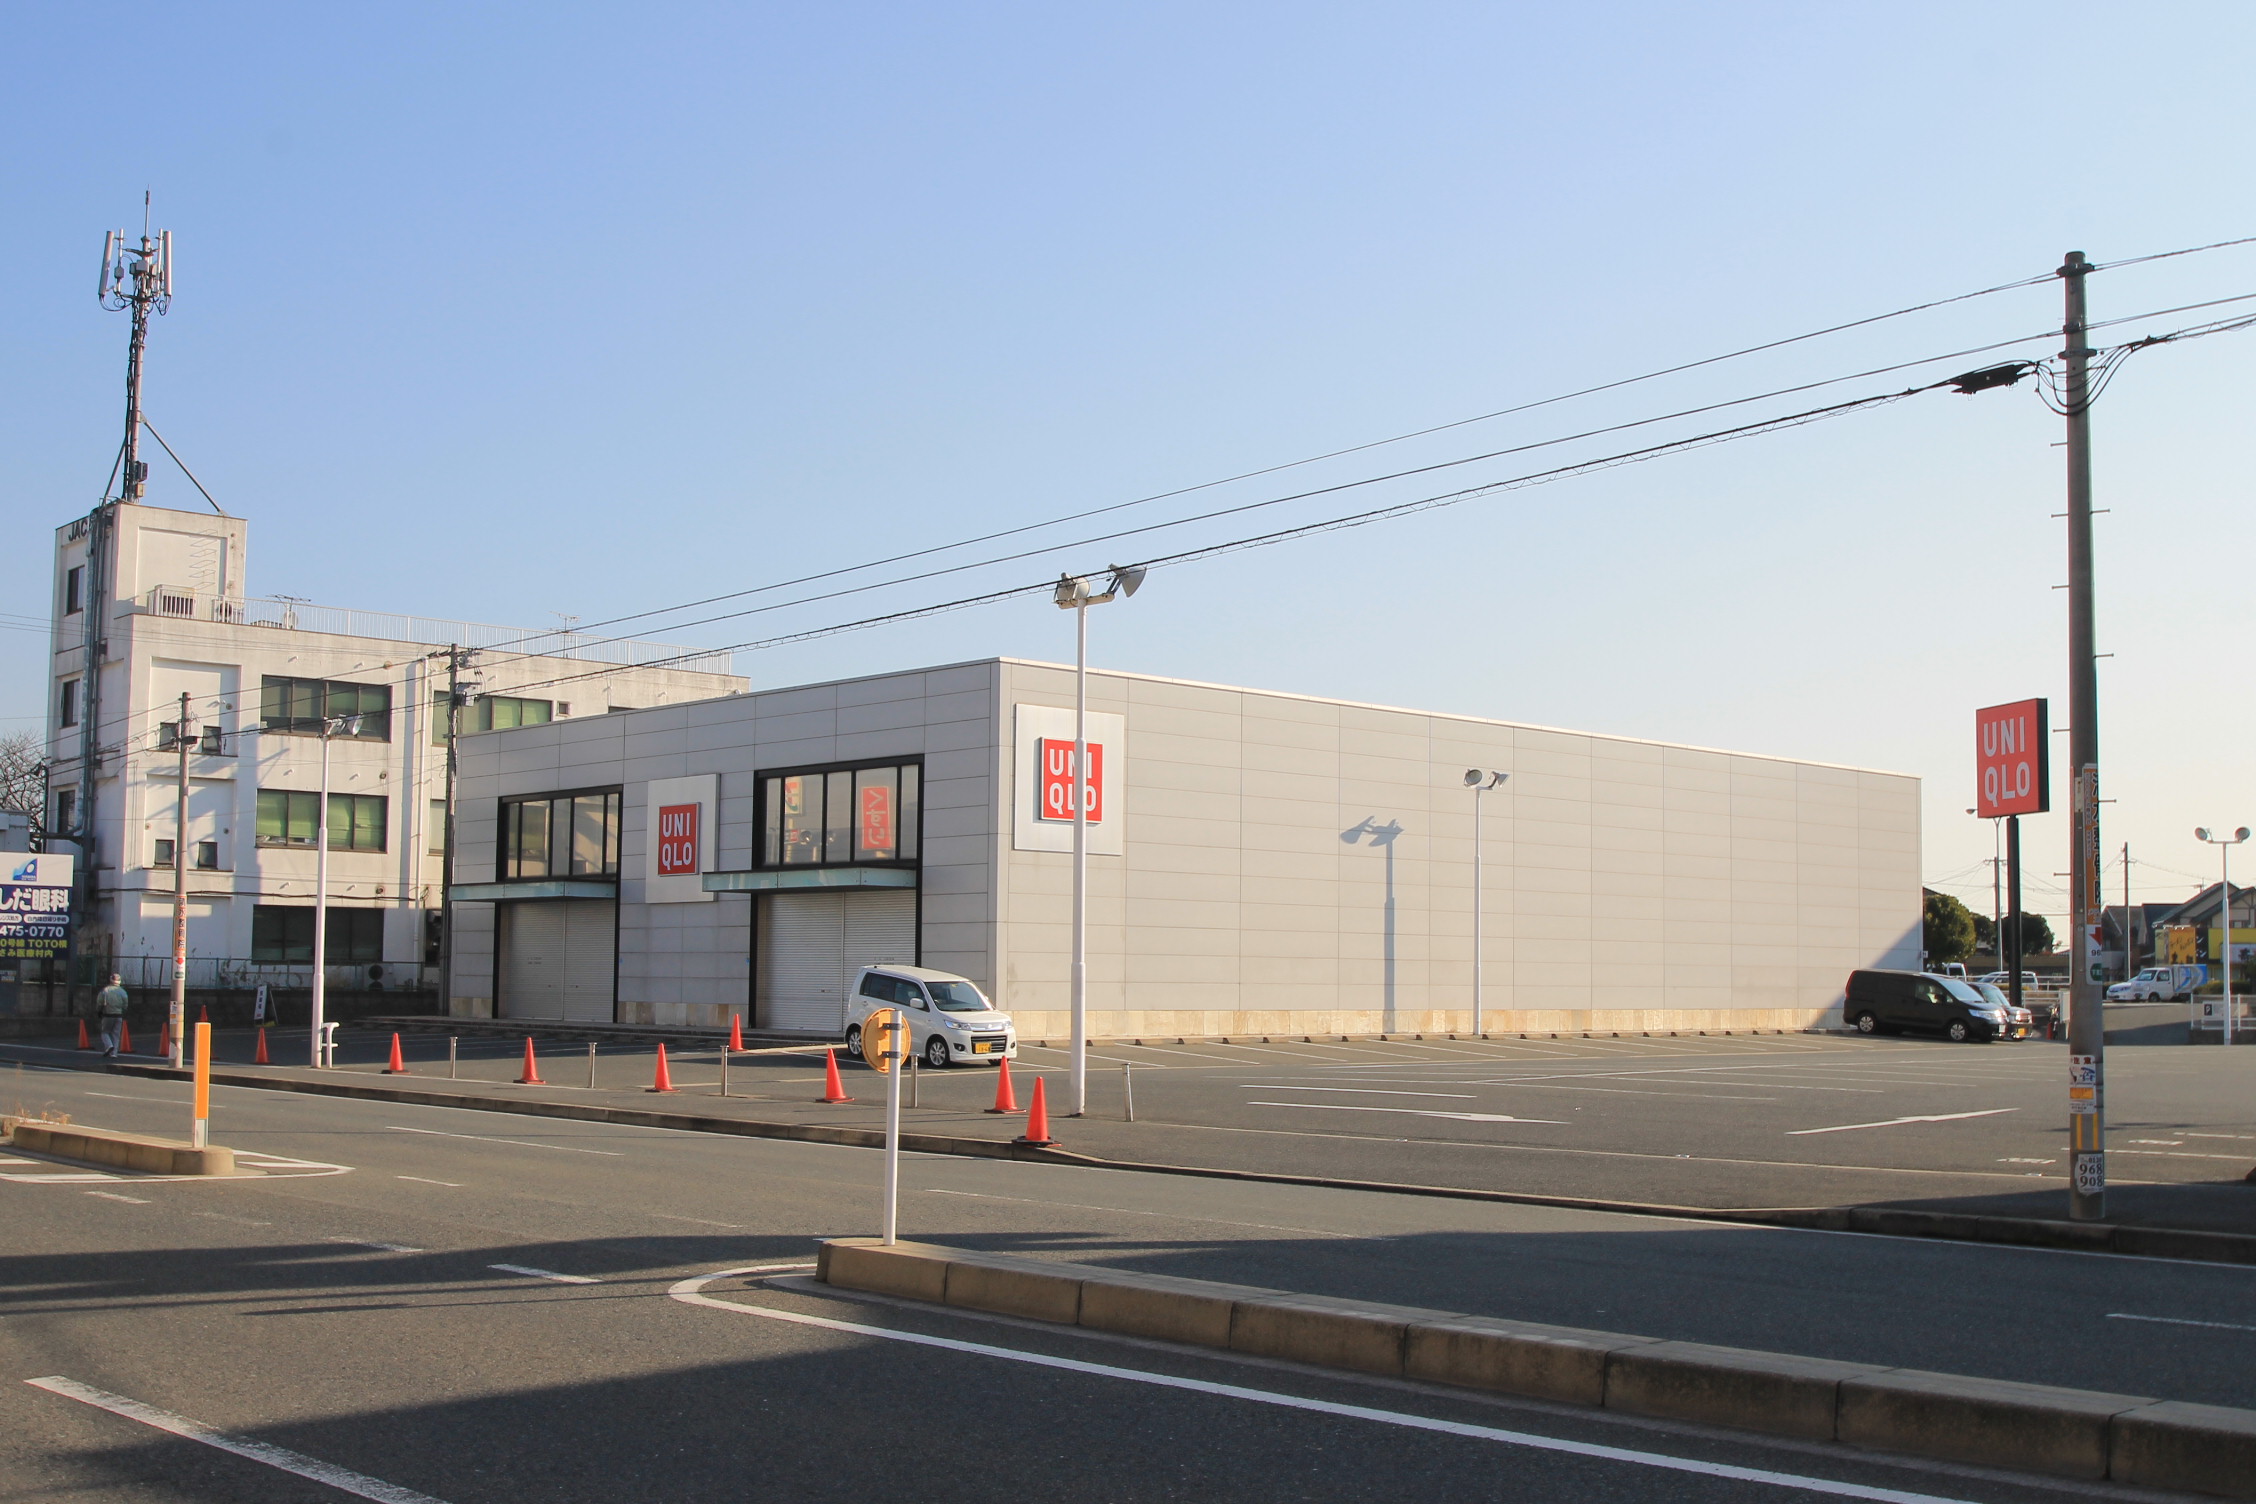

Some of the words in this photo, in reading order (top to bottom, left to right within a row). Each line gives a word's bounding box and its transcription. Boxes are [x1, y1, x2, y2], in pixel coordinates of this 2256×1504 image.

[1983, 716, 2025, 757] UNI
[1984, 761, 2030, 808] QLO
[662, 812, 691, 838] UNI
[661, 842, 692, 871] QLO
[0, 887, 70, 913] しだ眼科
[0, 925, 65, 937] 475-0770
[2079, 1163, 2103, 1175] 968
[2080, 1176, 2103, 1187] 908
